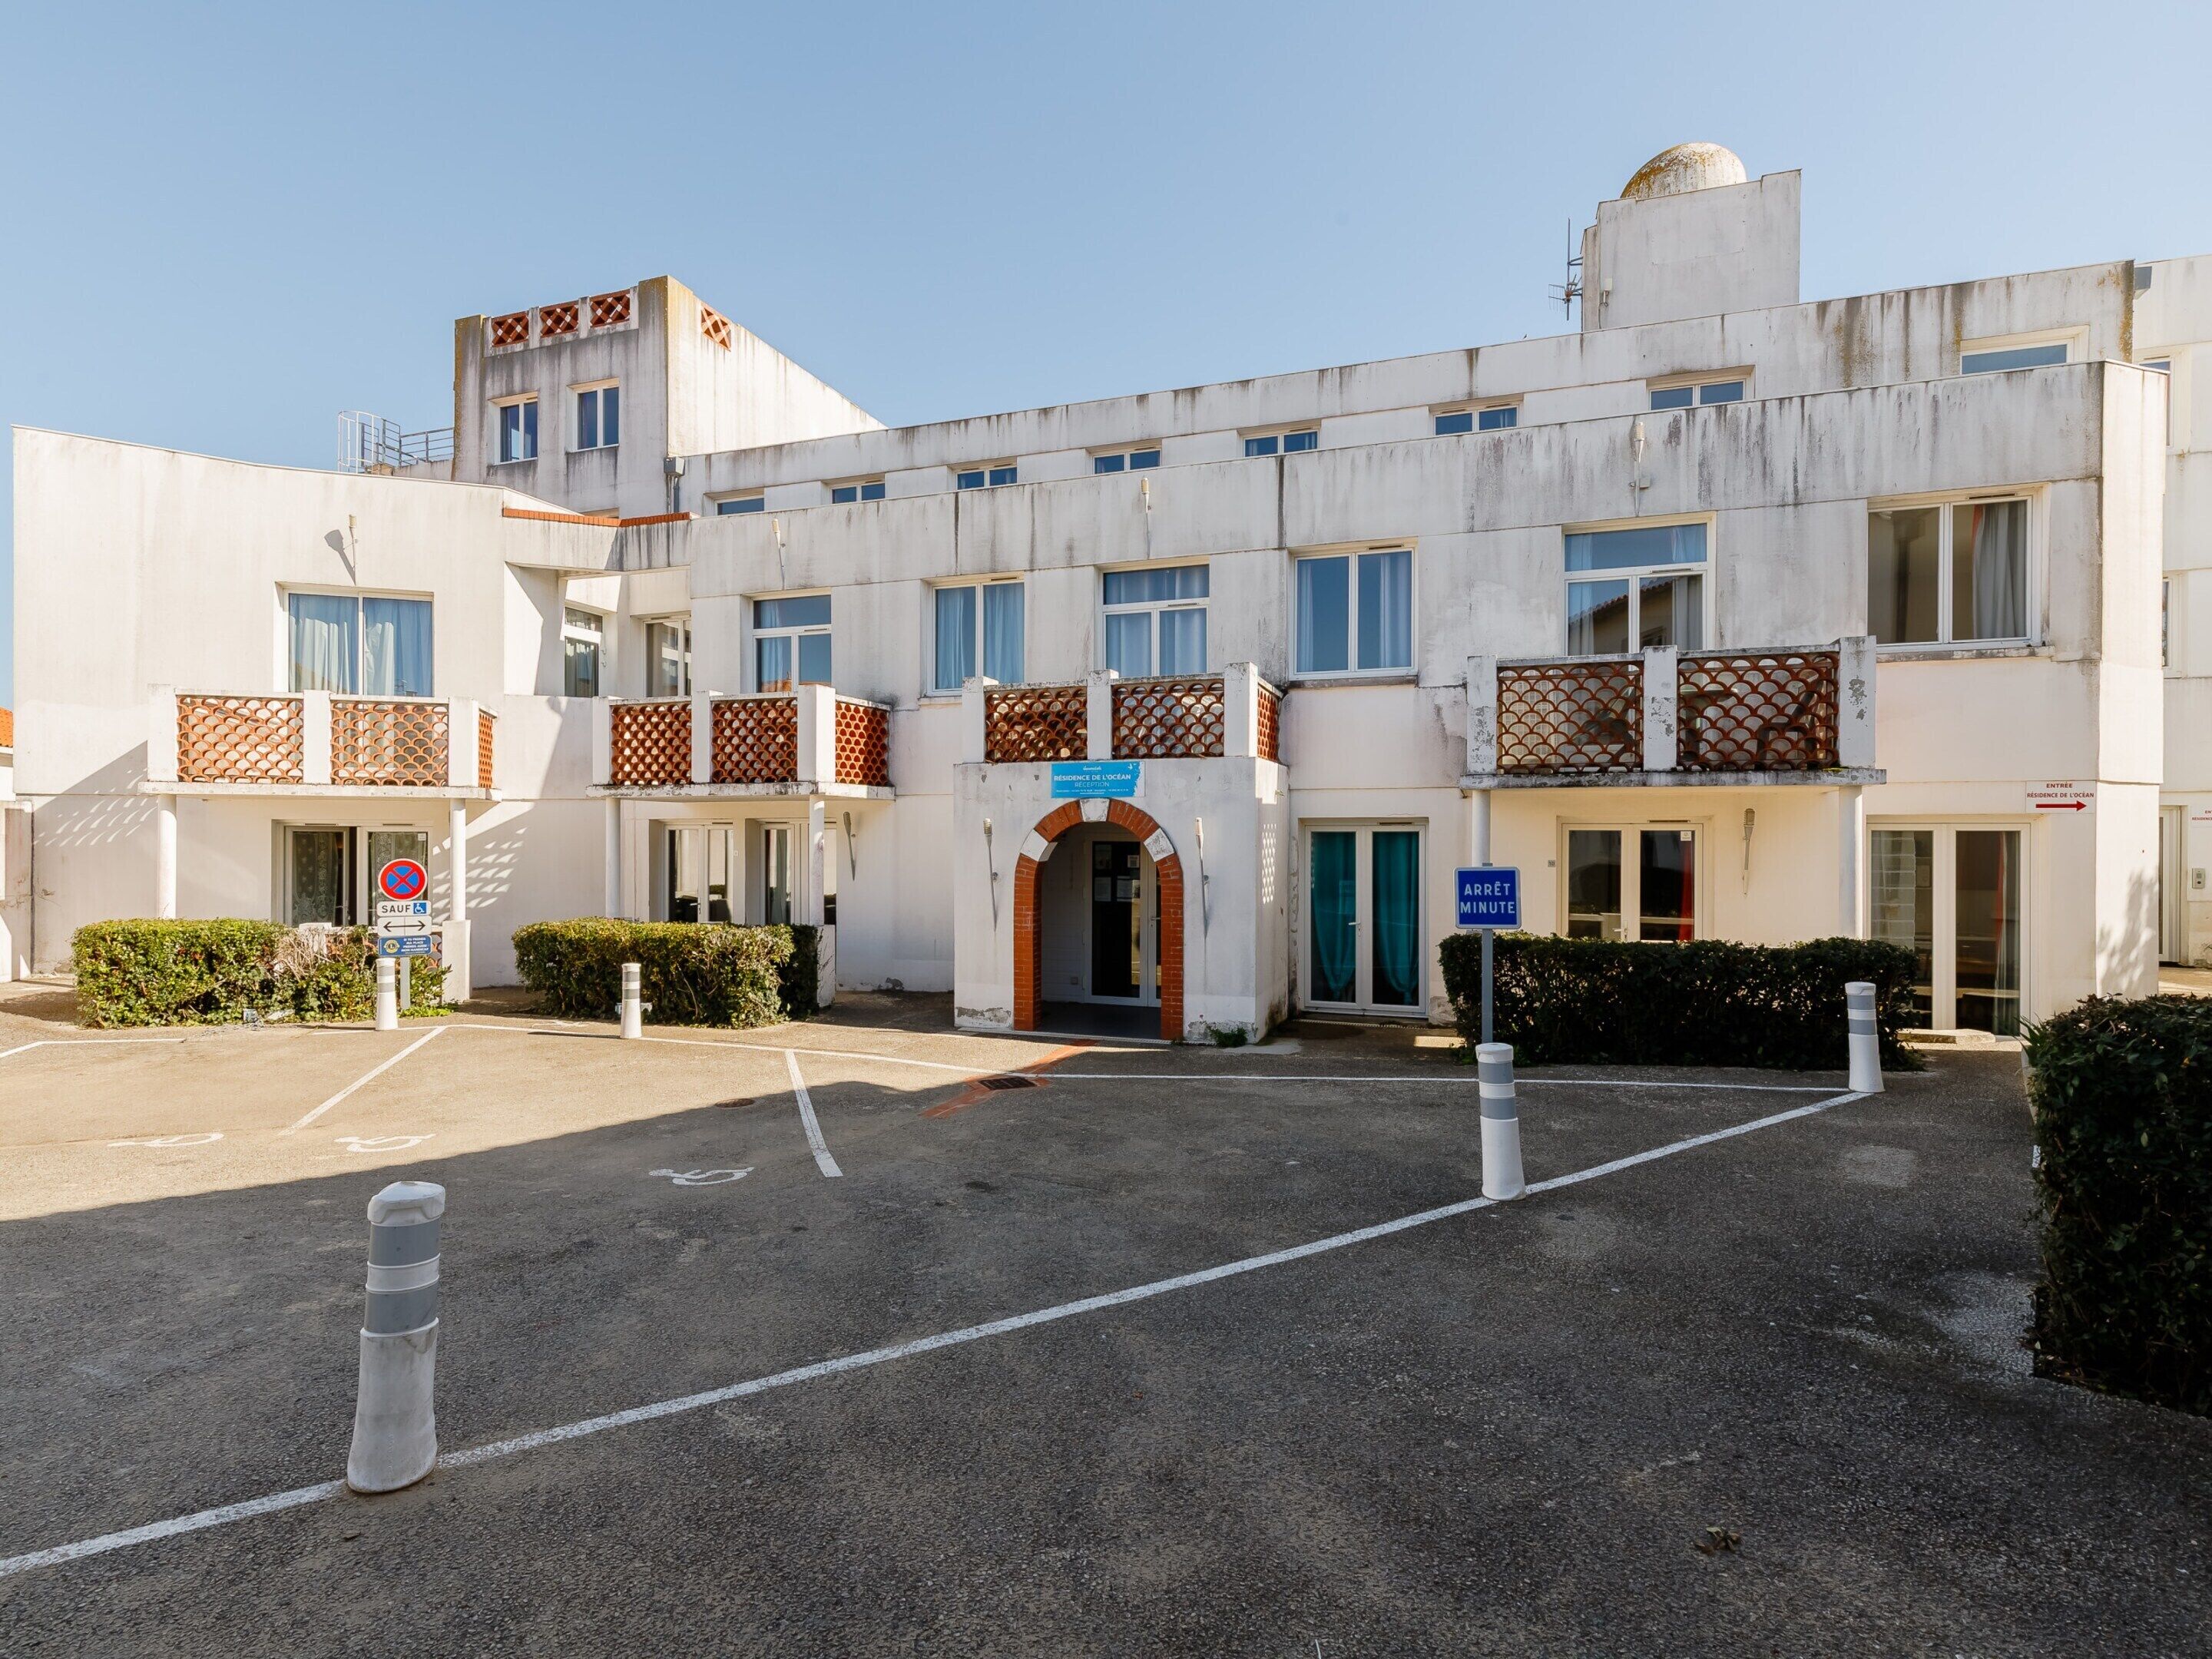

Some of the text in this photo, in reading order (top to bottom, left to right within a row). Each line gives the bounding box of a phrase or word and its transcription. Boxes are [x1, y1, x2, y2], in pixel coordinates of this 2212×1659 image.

[1464, 881, 1511, 896] ARRÊT
[381, 905, 411, 913] SAUF
[1460, 901, 1515, 914] MINUTE
